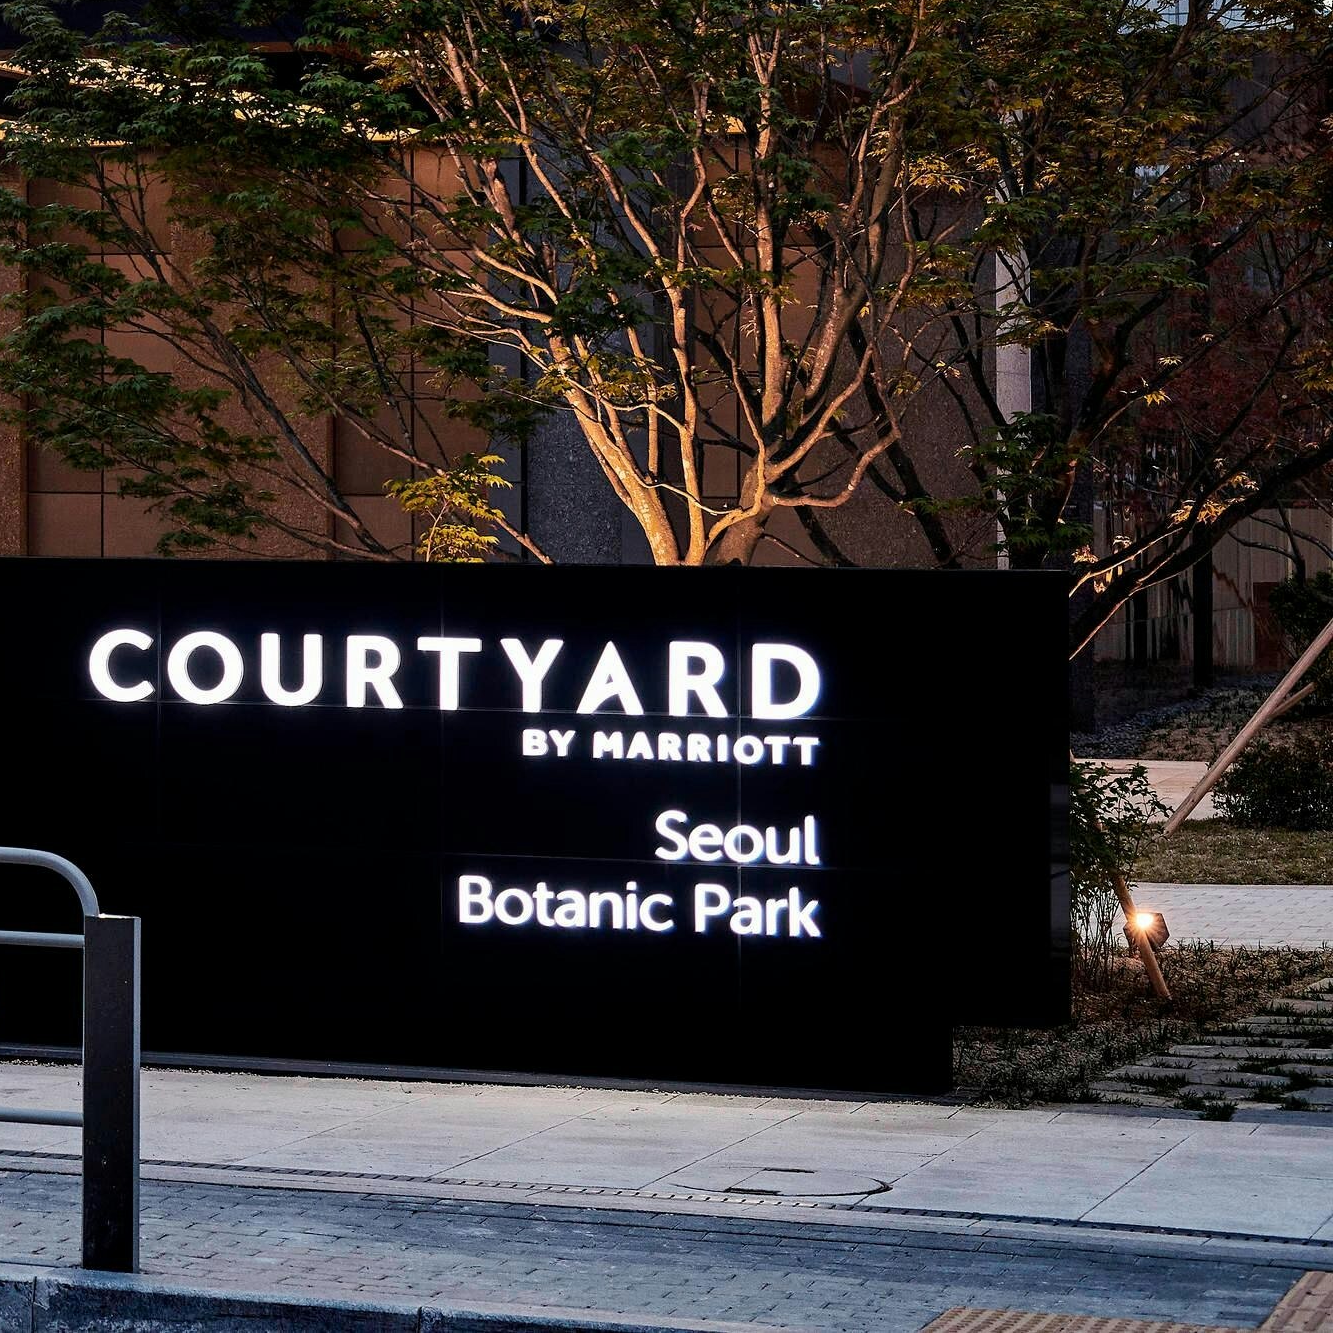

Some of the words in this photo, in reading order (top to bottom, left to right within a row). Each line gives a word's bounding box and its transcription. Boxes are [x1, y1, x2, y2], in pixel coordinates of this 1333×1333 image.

[88, 628, 821, 721] COURTYARD
[522, 728, 576, 757] BY
[592, 730, 820, 766] MARRIOTT
[654, 809, 821, 868] Seoul
[458, 874, 674, 933] Botanic
[694, 882, 821, 938] Park
